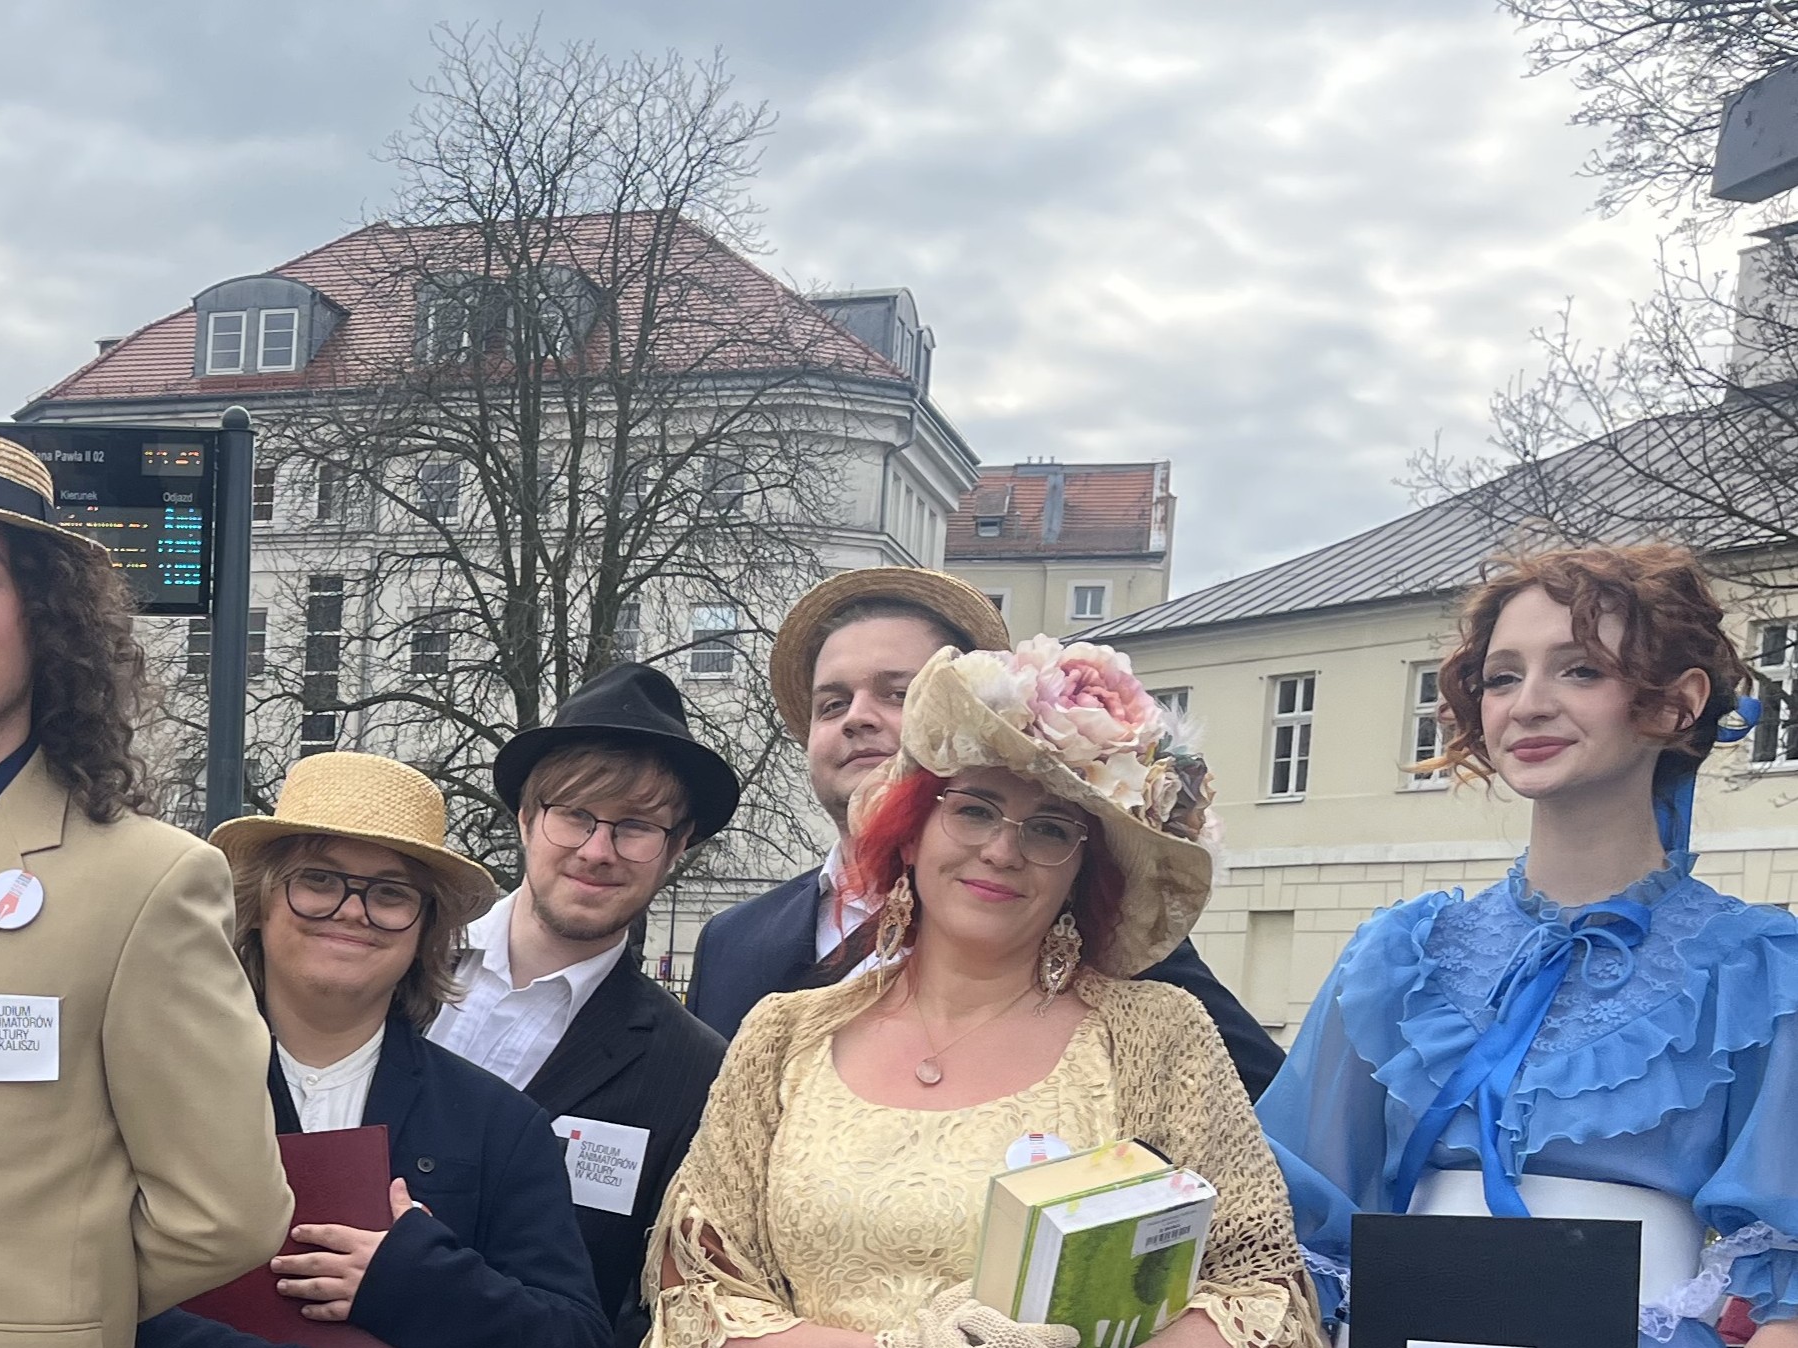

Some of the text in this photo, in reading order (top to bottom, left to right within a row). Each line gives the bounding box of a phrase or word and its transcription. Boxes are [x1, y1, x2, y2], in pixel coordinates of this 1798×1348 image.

[54, 449, 83, 462] Pawła
[92, 450, 105, 463] 02
[60, 490, 98, 501] Kierunek
[162, 491, 194, 504] Odjazd
[580, 1140, 621, 1156] STUDIUM
[576, 1160, 616, 1175] KULTURY
[578, 1150, 638, 1170] ANIMATORÓW
[575, 1168, 623, 1187] W KALISZU
